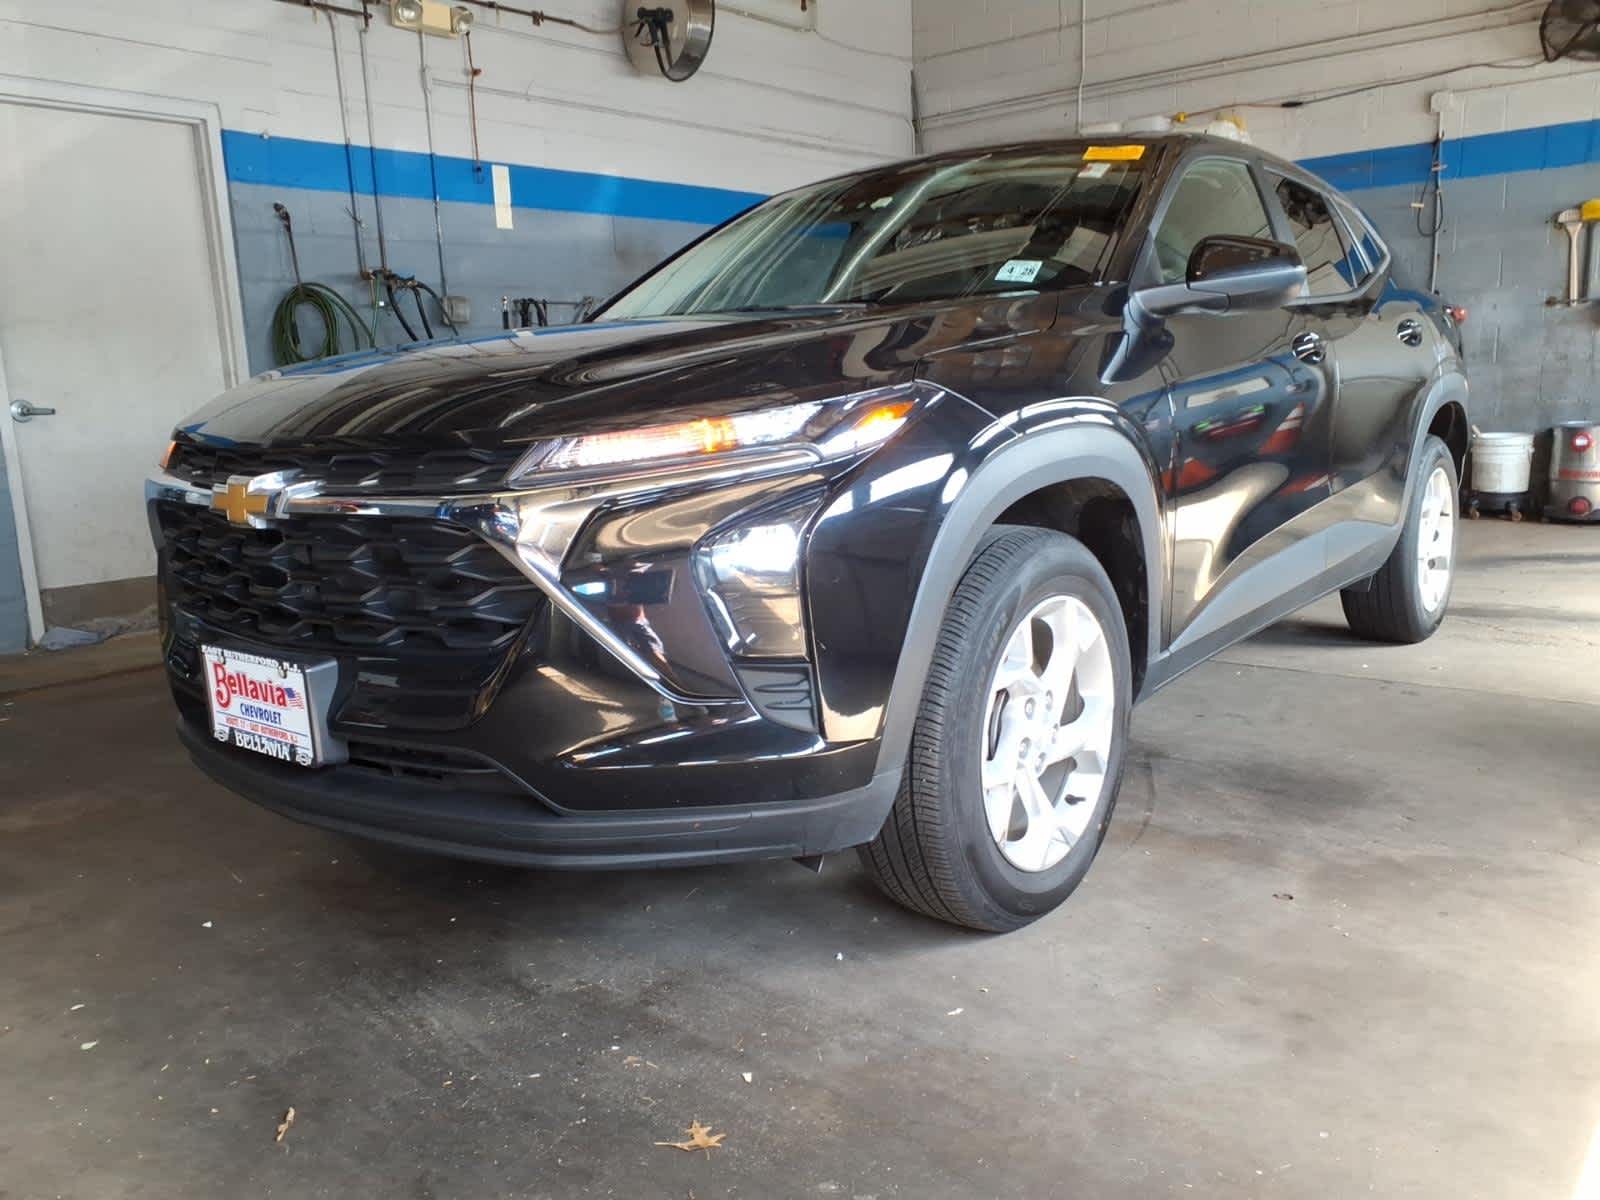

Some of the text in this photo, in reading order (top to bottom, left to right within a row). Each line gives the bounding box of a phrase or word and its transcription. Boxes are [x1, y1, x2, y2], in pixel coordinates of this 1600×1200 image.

[213, 662, 288, 709] Bellavia
[240, 703, 282, 725] CHEVROLET
[234, 729, 290, 761] BELLAVIA
